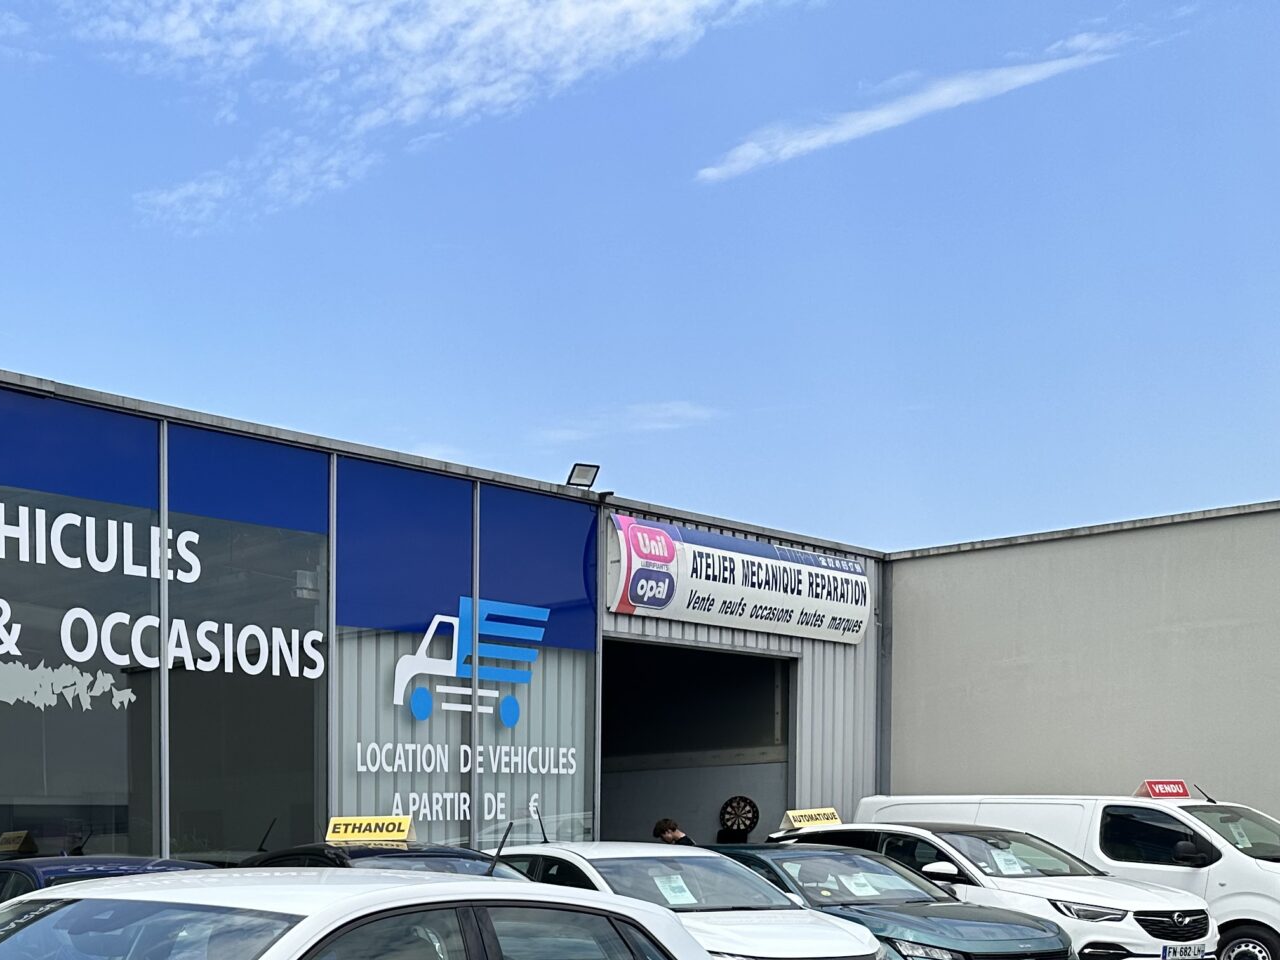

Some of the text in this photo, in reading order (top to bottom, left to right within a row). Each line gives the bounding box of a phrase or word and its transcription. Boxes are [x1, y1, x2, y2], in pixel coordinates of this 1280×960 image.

[636, 531, 669, 557] Unil
[636, 578, 670, 602] opal
[690, 549, 867, 607] ATELIER MECANIQUE REPARATION
[686, 589, 863, 636] Vente neufs occasions toutes marques
[60, 606, 326, 680] OCCASIONS
[356, 742, 449, 773] LOCATION
[488, 745, 577, 775] VEHICULES
[1151, 784, 1184, 794] VENDU
[392, 792, 408, 817] A
[409, 792, 471, 821] PARTIR
[484, 792, 506, 820] DE
[791, 811, 838, 823] AUTOMATIQUE
[331, 822, 406, 834] ETHANOL
